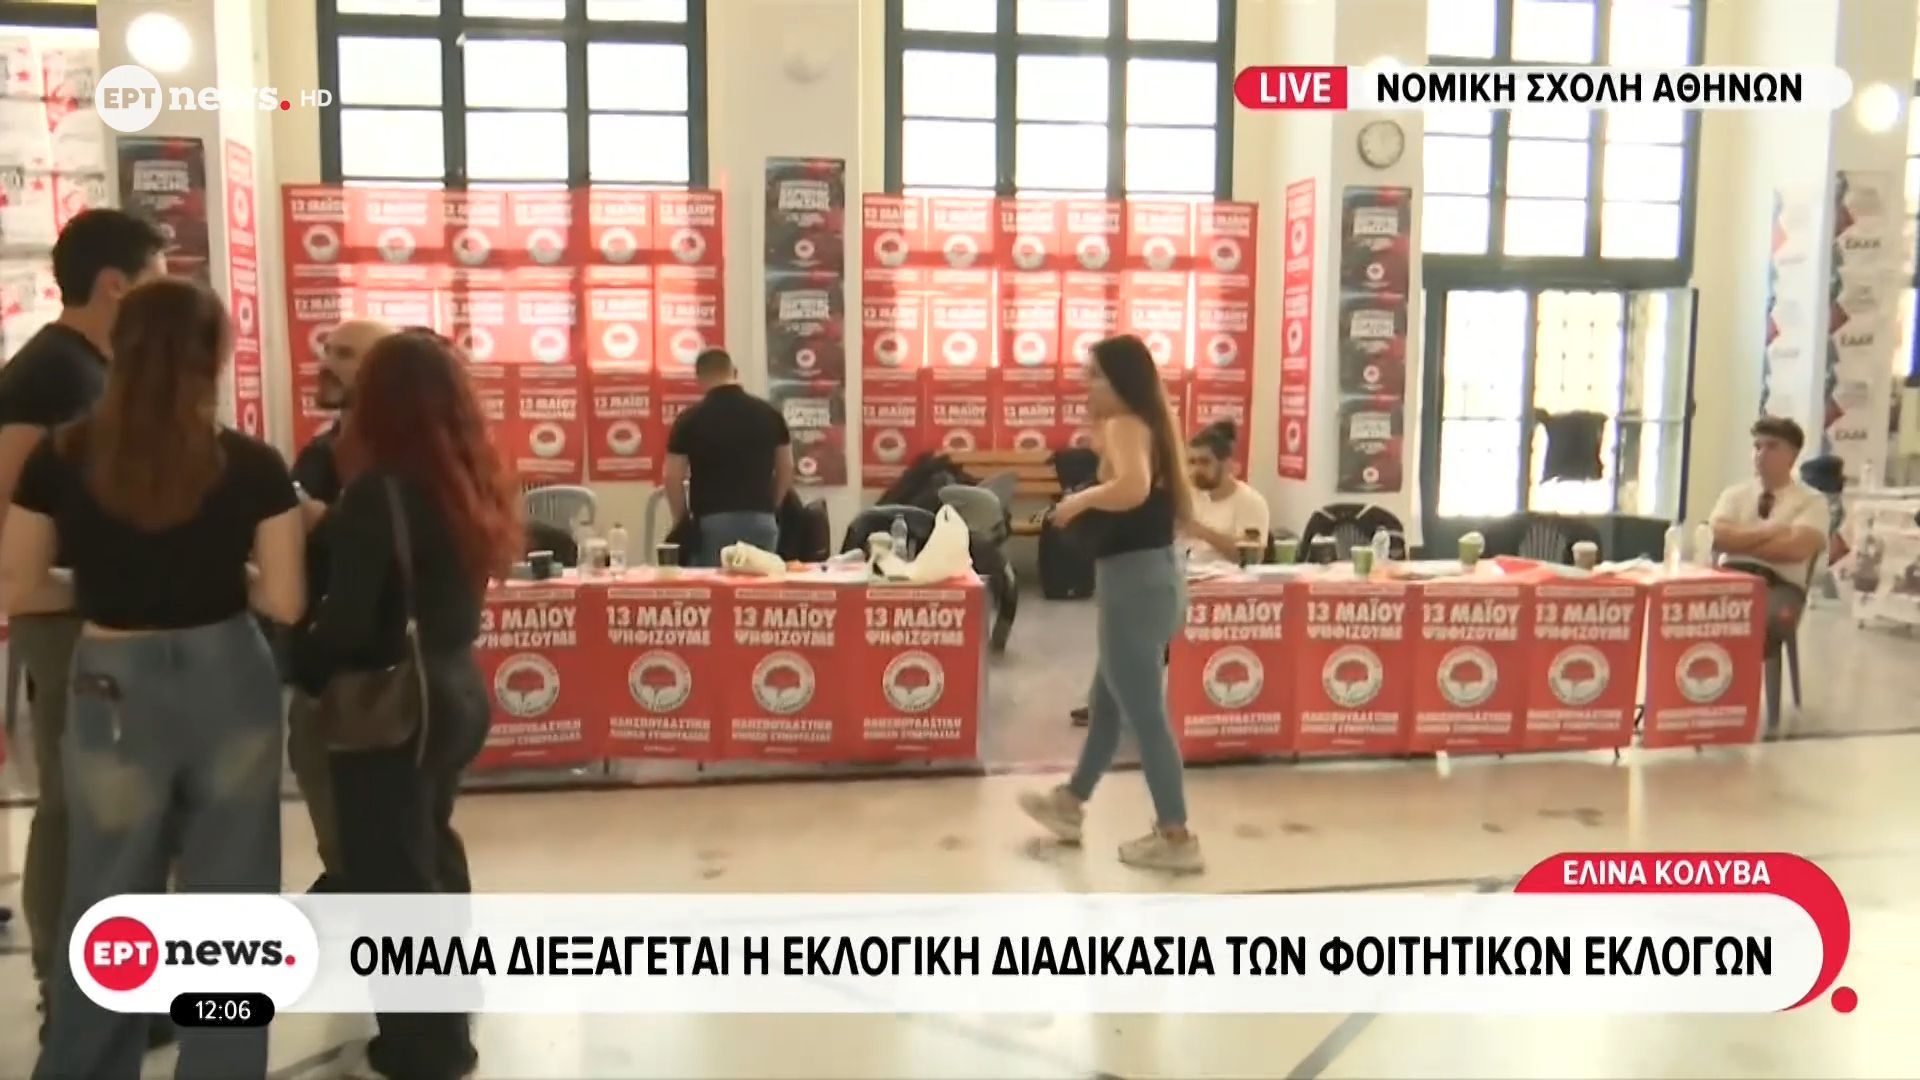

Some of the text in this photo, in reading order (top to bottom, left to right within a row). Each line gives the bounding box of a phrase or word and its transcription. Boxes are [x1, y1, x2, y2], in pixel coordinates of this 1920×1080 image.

[480, 602, 577, 630] 3 ΜΑΪΟΥ
[606, 601, 712, 628] 13 ΜΑΪΟΥ
[733, 602, 837, 628] 13 ΜΑΪΟΥ
[864, 602, 966, 628] 13 ΜΑΪΟΥ
[1185, 599, 1284, 624] 13 ΜΑΪΟΥ
[1307, 598, 1406, 622] 13 ΜΑΪΟΥ
[1423, 599, 1521, 624] 13 ΜΑΪΟΥ
[1535, 598, 1635, 623] 13 ΜΑΪΟΥ
[1661, 595, 1753, 621] 13 ΜΑΪΟΥ
